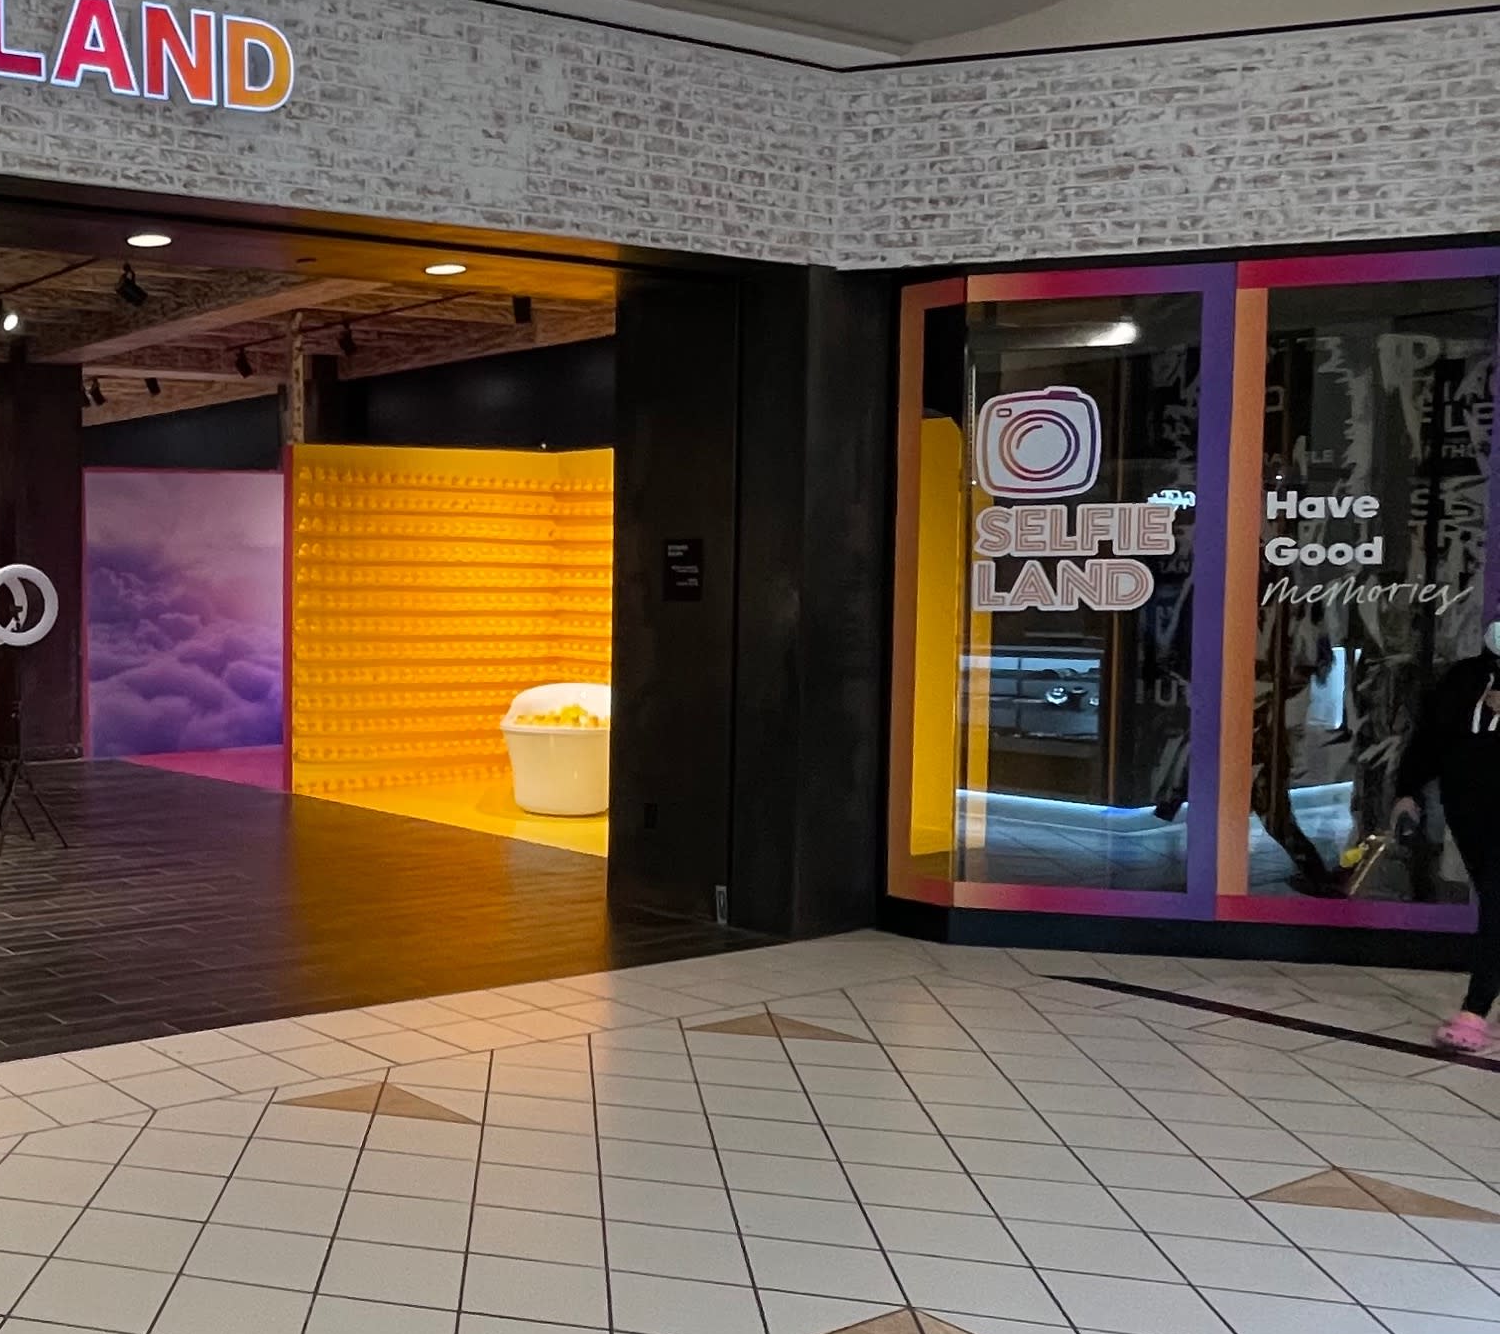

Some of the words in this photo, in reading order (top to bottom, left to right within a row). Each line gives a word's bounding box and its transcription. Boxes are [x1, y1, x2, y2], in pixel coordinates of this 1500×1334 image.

[1266, 490, 1380, 519] Have
[977, 504, 1173, 554] SELFIE
[1265, 536, 1383, 566] Good
[975, 560, 1152, 608] LAND
